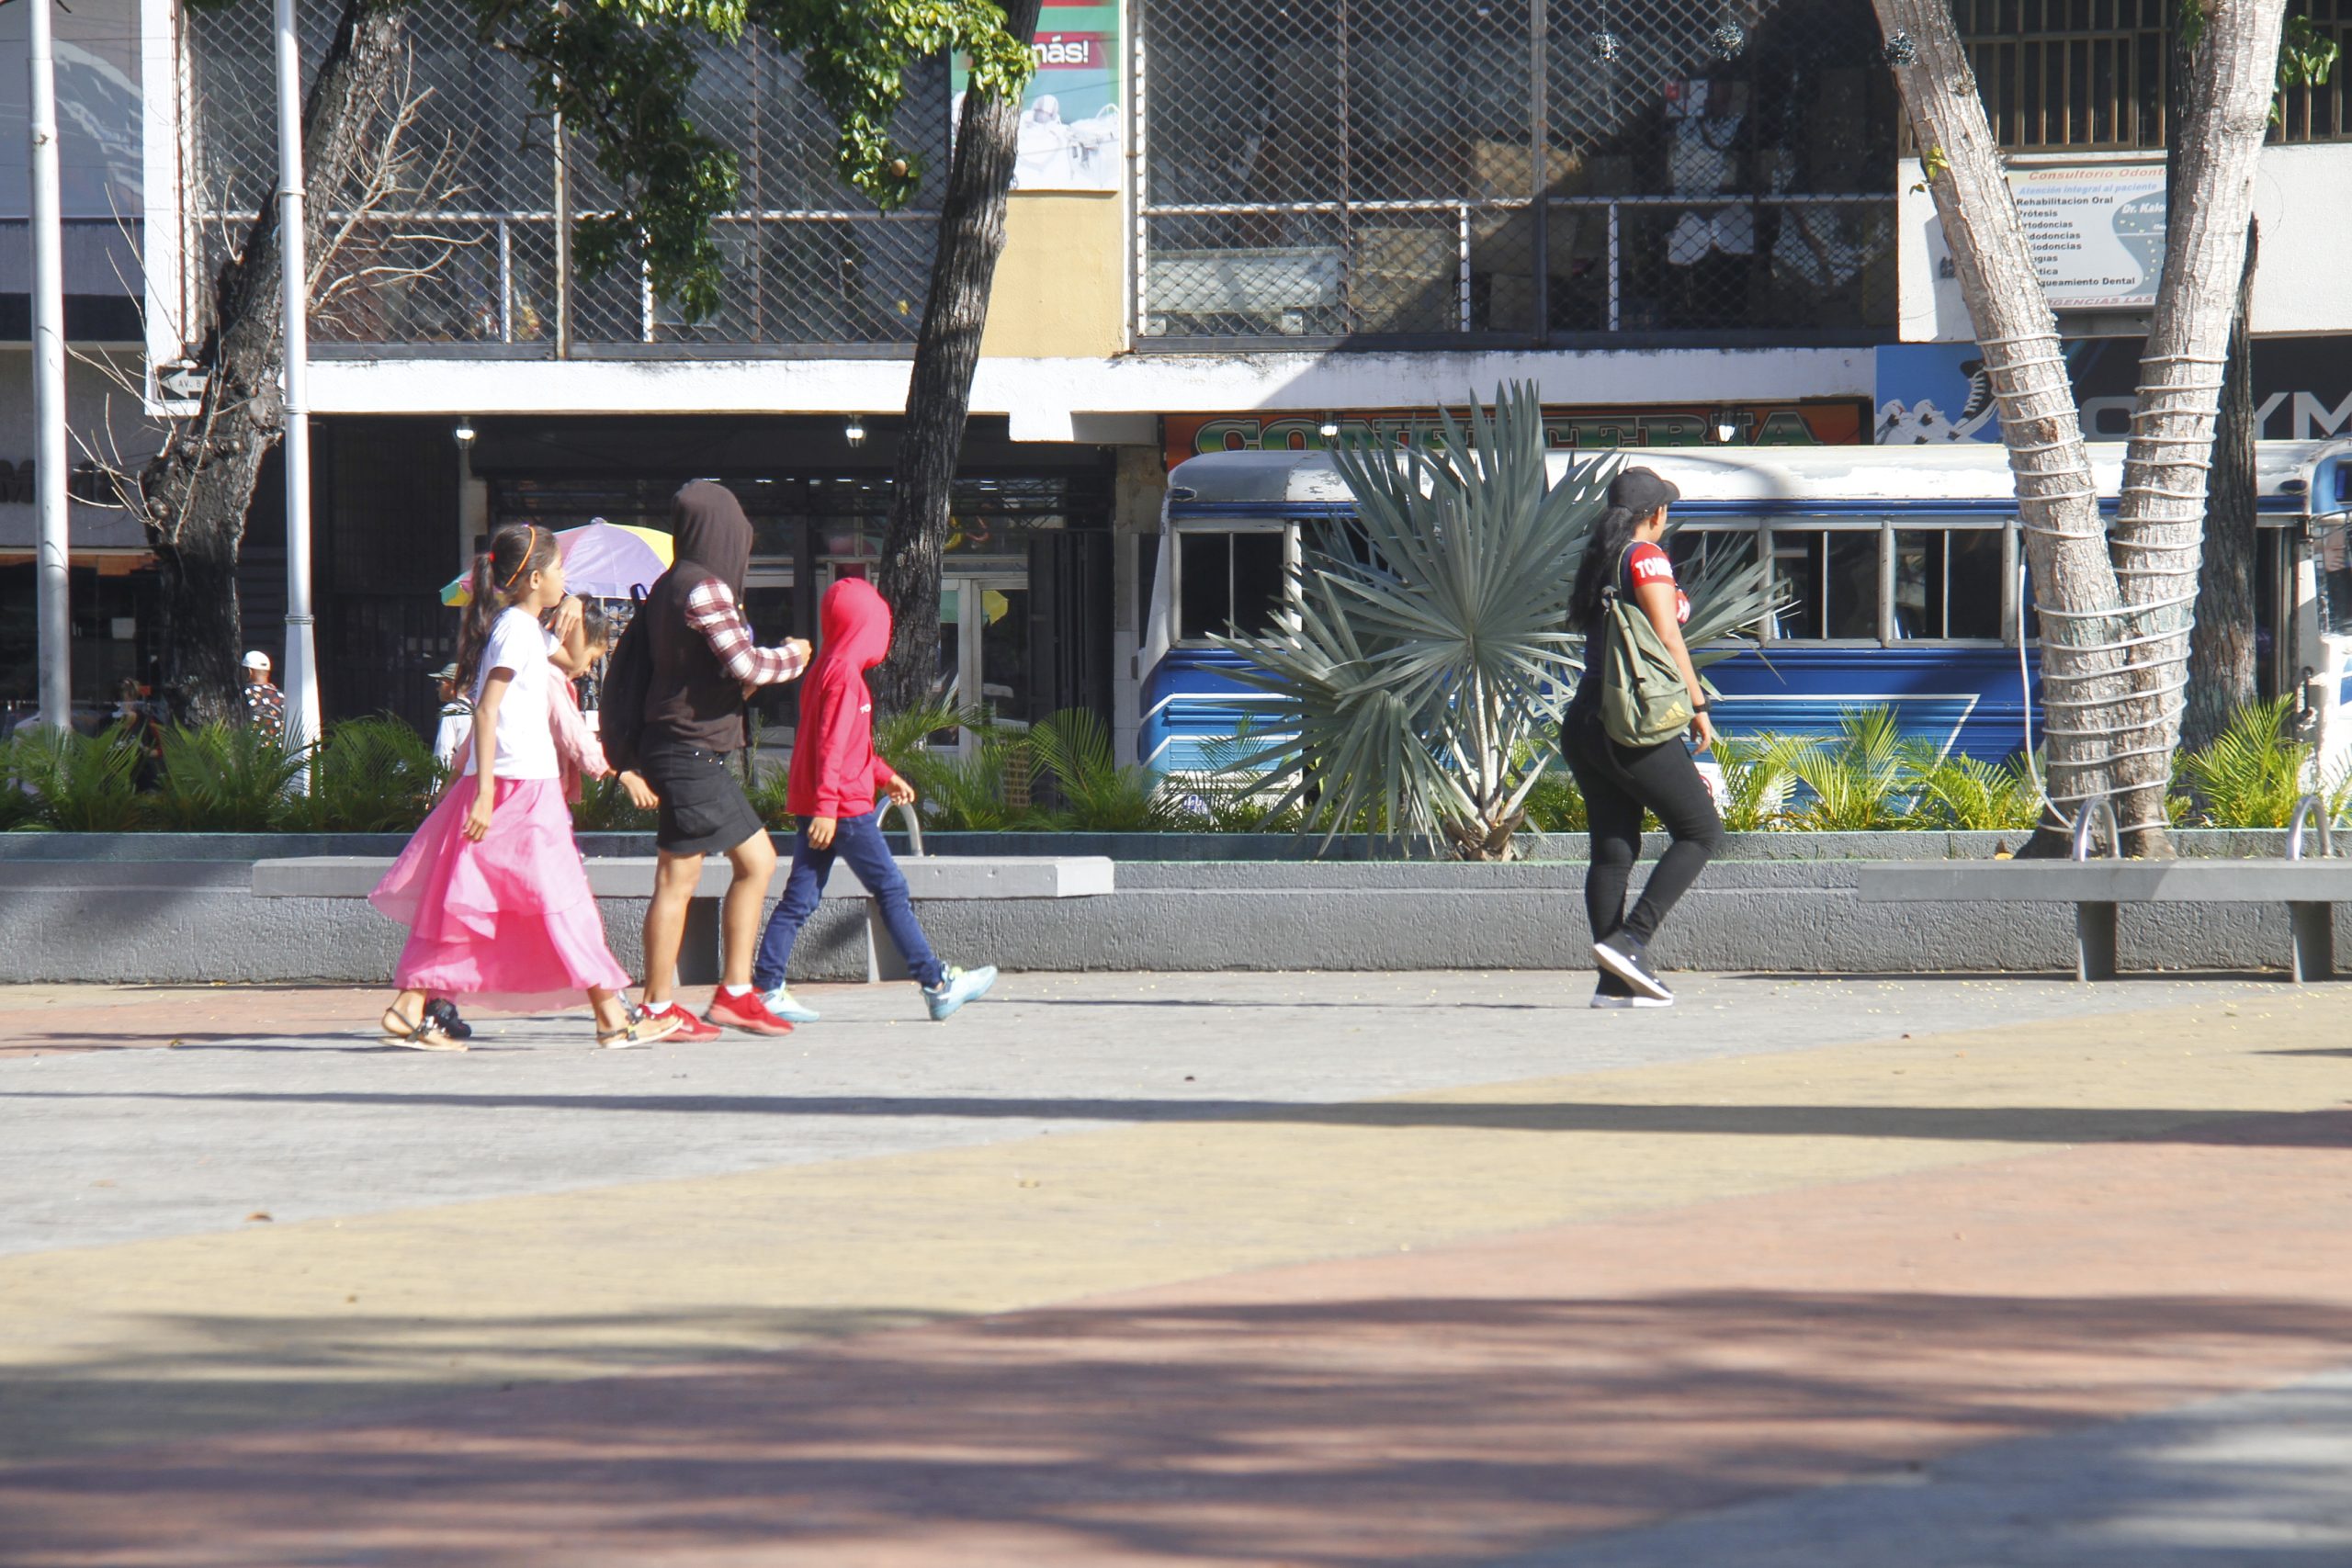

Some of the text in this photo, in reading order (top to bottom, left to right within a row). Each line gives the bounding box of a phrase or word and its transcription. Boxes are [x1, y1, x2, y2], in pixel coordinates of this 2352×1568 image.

[2029, 167, 2166, 181] Consultorio Odont
[2064, 185, 2101, 194] integral
[2115, 183, 2157, 192] paciente
[2092, 196, 2113, 204] Oral
[2121, 204, 2138, 214] Dr.
[2027, 231, 2081, 240] dodoncias
[2124, 295, 2154, 303] LAS
[1194, 412, 1824, 455] CONFTERIA
